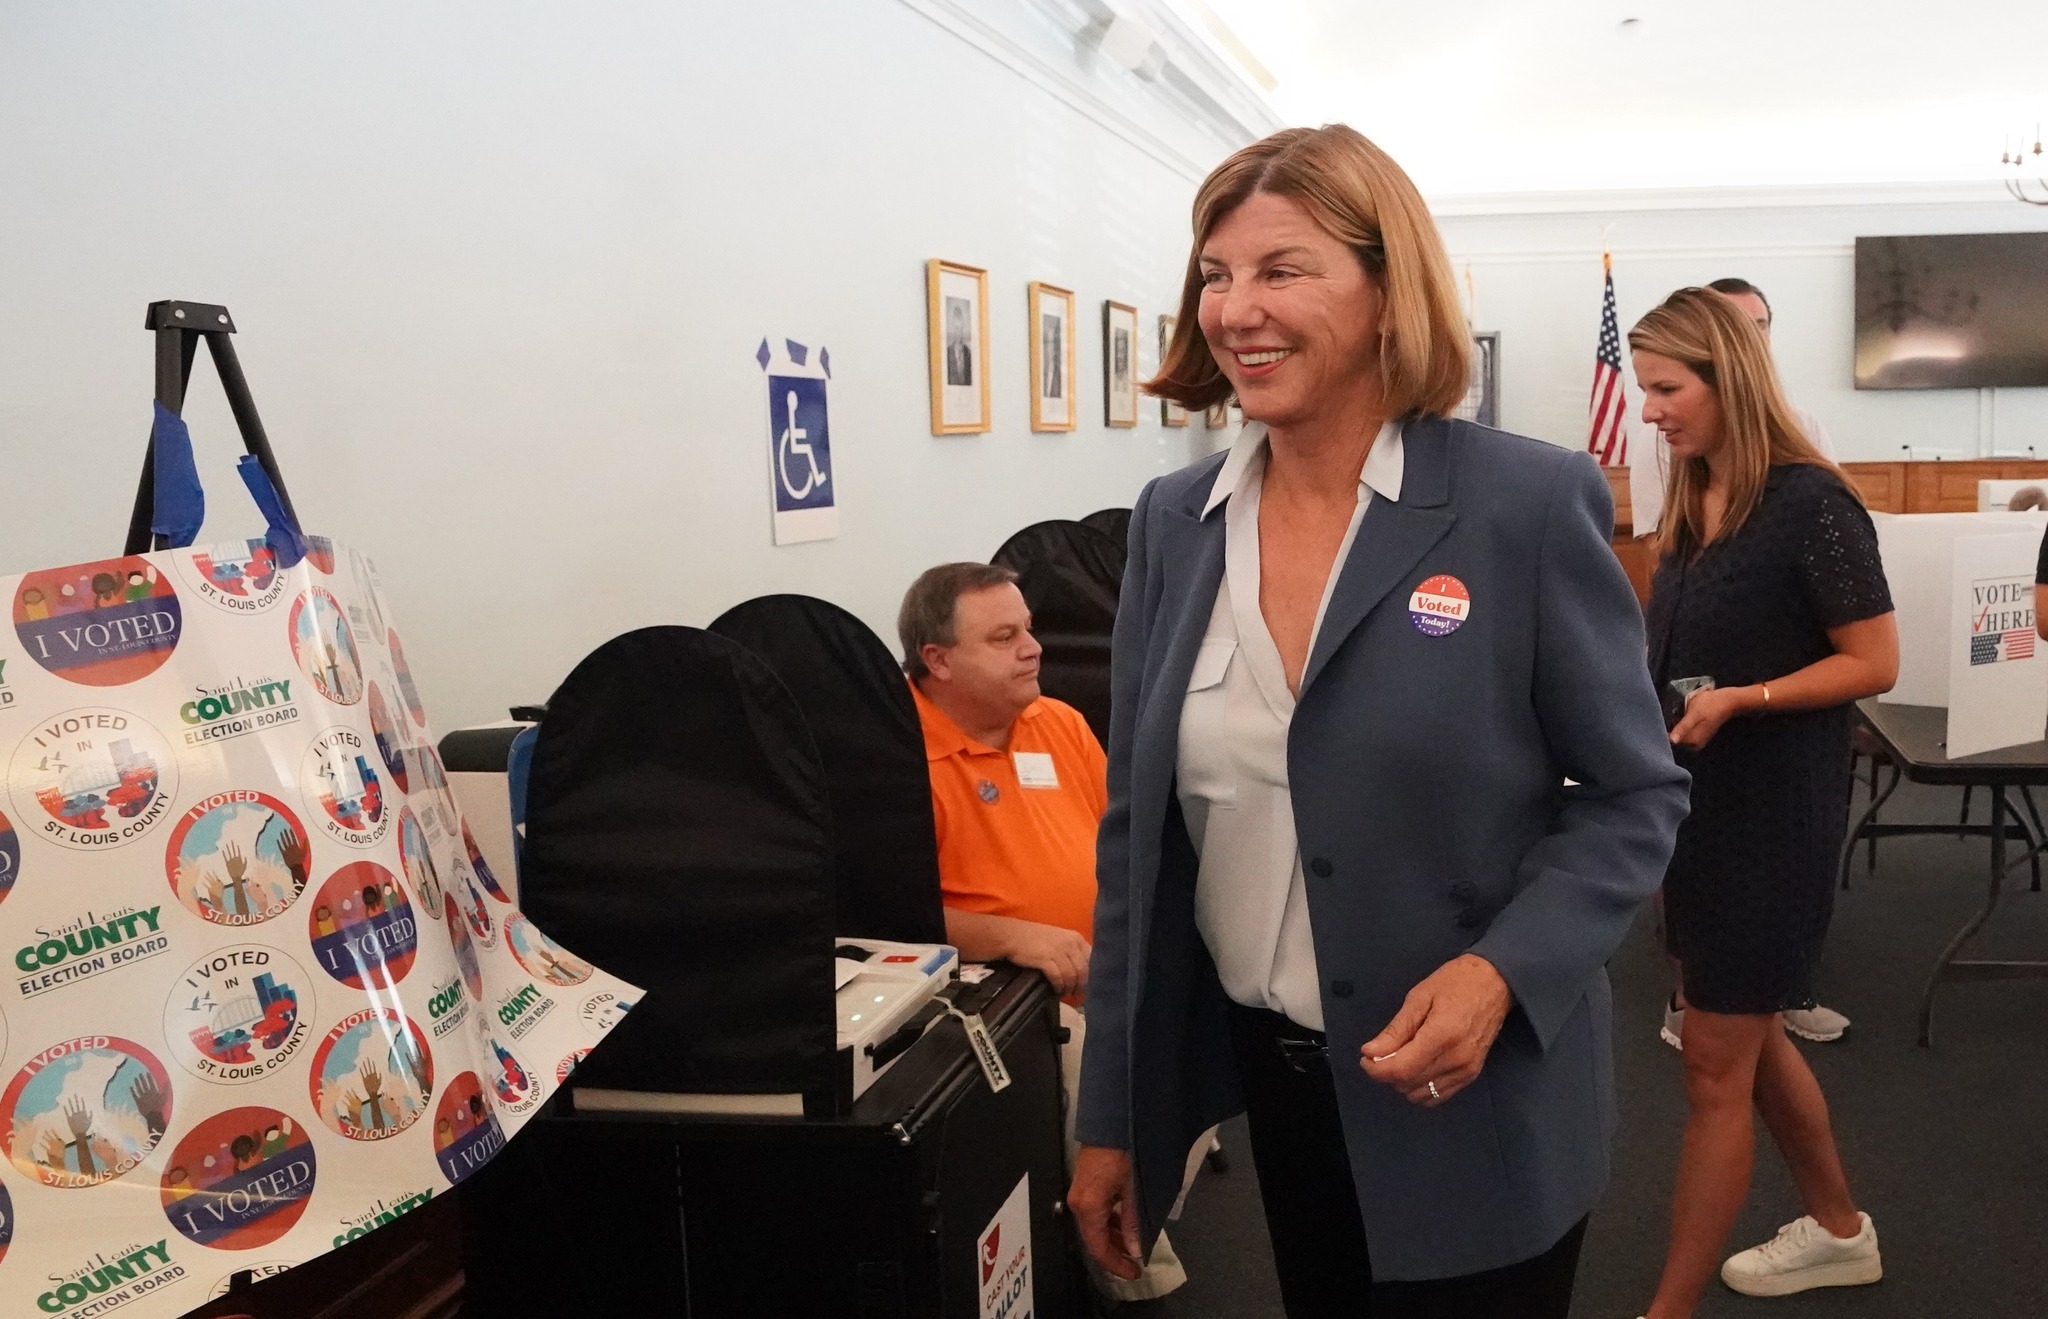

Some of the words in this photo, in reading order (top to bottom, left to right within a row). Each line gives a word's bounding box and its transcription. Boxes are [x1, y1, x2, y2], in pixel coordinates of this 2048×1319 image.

[200, 582, 216, 600] ST.
[219, 595, 256, 610] LOUIS
[257, 573, 285, 608] COUNTY
[1417, 596, 1462, 616] Voted
[1440, 583, 1447, 593] I
[1973, 583, 2021, 605] VOTE
[34, 634, 51, 659] I
[58, 611, 175, 652] VOTED
[1420, 615, 1450, 629] Today!
[1986, 609, 2035, 632] HERE
[180, 679, 292, 725] COUNTY
[195, 680, 234, 699] Saint
[34, 736, 47, 748] I
[45, 714, 128, 739] VOTED
[76, 739, 93, 752] IN
[184, 718, 253, 745] ELECTION
[257, 707, 299, 727] BOARD
[313, 747, 322, 757] I
[320, 732, 362, 750] VOTED
[44, 821, 66, 839] ST.
[69, 831, 120, 845] LOUIS
[123, 791, 169, 838] COUNTY
[186, 810, 199, 820] I
[199, 790, 260, 814] VOTED
[327, 821, 341, 837] ST.
[344, 831, 373, 844] LOUIS
[373, 805, 390, 840] COUNTY
[205, 908, 222, 922] ST.
[225, 911, 265, 926] LOUIS
[265, 879, 305, 918] COUNTY
[15, 905, 161, 972] COUNTY
[34, 917, 84, 943] Saint
[88, 905, 136, 925] Louis
[326, 947, 339, 970] I
[343, 917, 414, 960] VOTED
[20, 957, 105, 995] ELECTION
[110, 936, 168, 965] BOARD
[186, 978, 198, 988] I
[196, 951, 270, 979] VOTED
[224, 977, 239, 990] IN
[498, 983, 542, 1026] COUNTY
[510, 1014, 537, 1040] ELECTION
[534, 998, 555, 1018] BOARD
[583, 993, 615, 1015] VOTED
[328, 1032, 339, 1041] I
[433, 1013, 464, 1037] ELECTION
[23, 1065, 37, 1076] I
[31, 1036, 110, 1067] VOTED
[197, 1059, 215, 1075] ST.
[219, 1064, 264, 1079] LOUIS
[266, 1021, 307, 1069] COUNTY
[509, 1100, 534, 1113] LOUIS
[526, 1071, 540, 1101] COUNTY
[345, 1126, 361, 1139] ST.
[364, 1126, 398, 1140] LOUIS
[400, 1089, 431, 1129] COUNTY
[44, 1171, 65, 1187] ST.
[68, 1167, 113, 1188] LOUIS
[114, 1127, 163, 1173] COUNTY
[449, 1158, 459, 1180] I
[183, 1211, 201, 1236] I
[203, 1161, 310, 1222] VOTED
[340, 1205, 376, 1231] Saint
[377, 1191, 414, 1212] Louis
[36, 1238, 172, 1313] COUNTY
[48, 1260, 95, 1288] Saint
[95, 1241, 143, 1266] Louis
[61, 1290, 131, 1319] ECTION
[132, 1266, 185, 1295] BOARD
[987, 1273, 1005, 1310] CAST
[991, 1265, 1027, 1319] ALLOT
